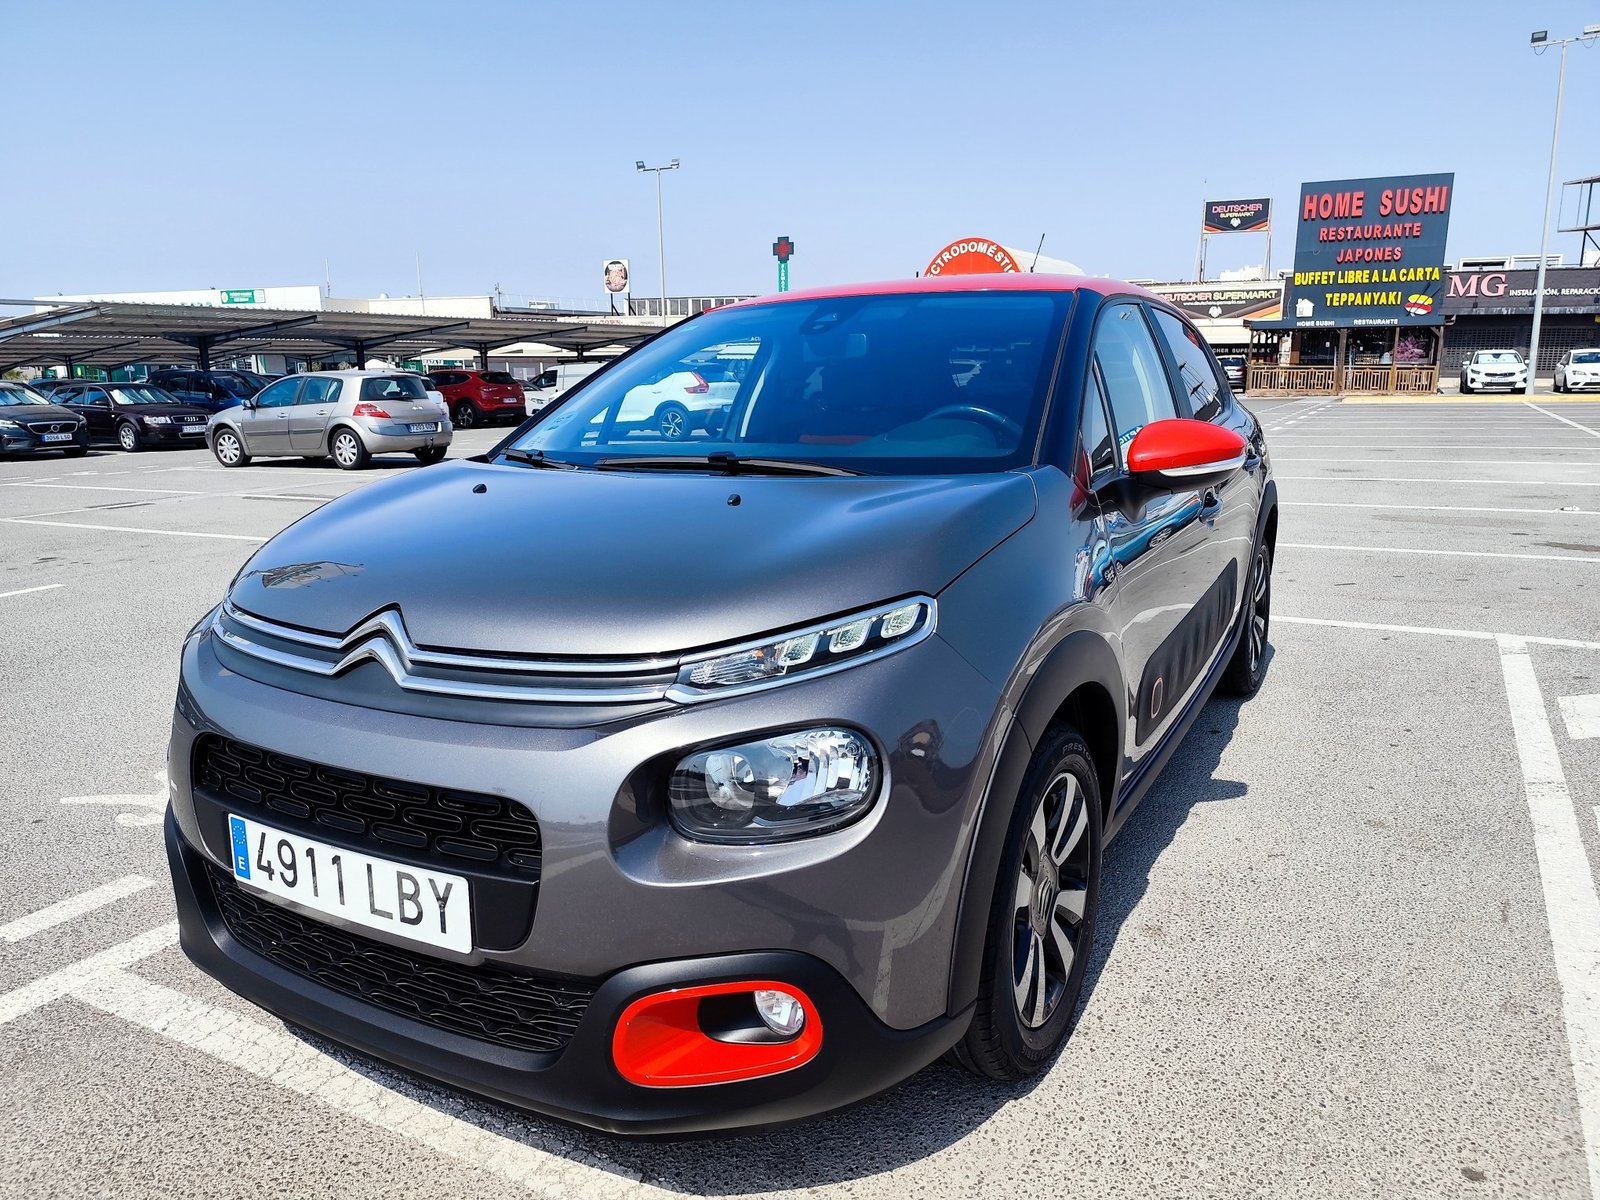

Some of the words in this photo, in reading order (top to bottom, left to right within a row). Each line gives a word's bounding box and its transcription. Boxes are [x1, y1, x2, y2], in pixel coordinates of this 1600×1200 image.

[1212, 203, 1263, 213] DEUTSCHER
[1303, 191, 1364, 220] HOME
[1380, 186, 1448, 216] SUSHI
[1320, 222, 1421, 241] RESTAURANTE
[927, 241, 1016, 277] CTRODOMÉSTI
[1336, 247, 1402, 263] JAPONES
[1294, 271, 1335, 285] BUFFET
[1337, 270, 1370, 284] LIBRE
[1371, 269, 1380, 283] A
[1382, 269, 1397, 282] LA
[1399, 267, 1440, 282] CARTA
[1446, 273, 1508, 297] MG
[1213, 290, 1277, 300] SUPERMARKT
[1326, 291, 1402, 306] TEPPANYAKI
[1509, 288, 1559, 296] INSTALAIÓN,
[238, 855, 246, 870] E
[256, 831, 345, 906] 4911
[366, 863, 454, 934] LBY
